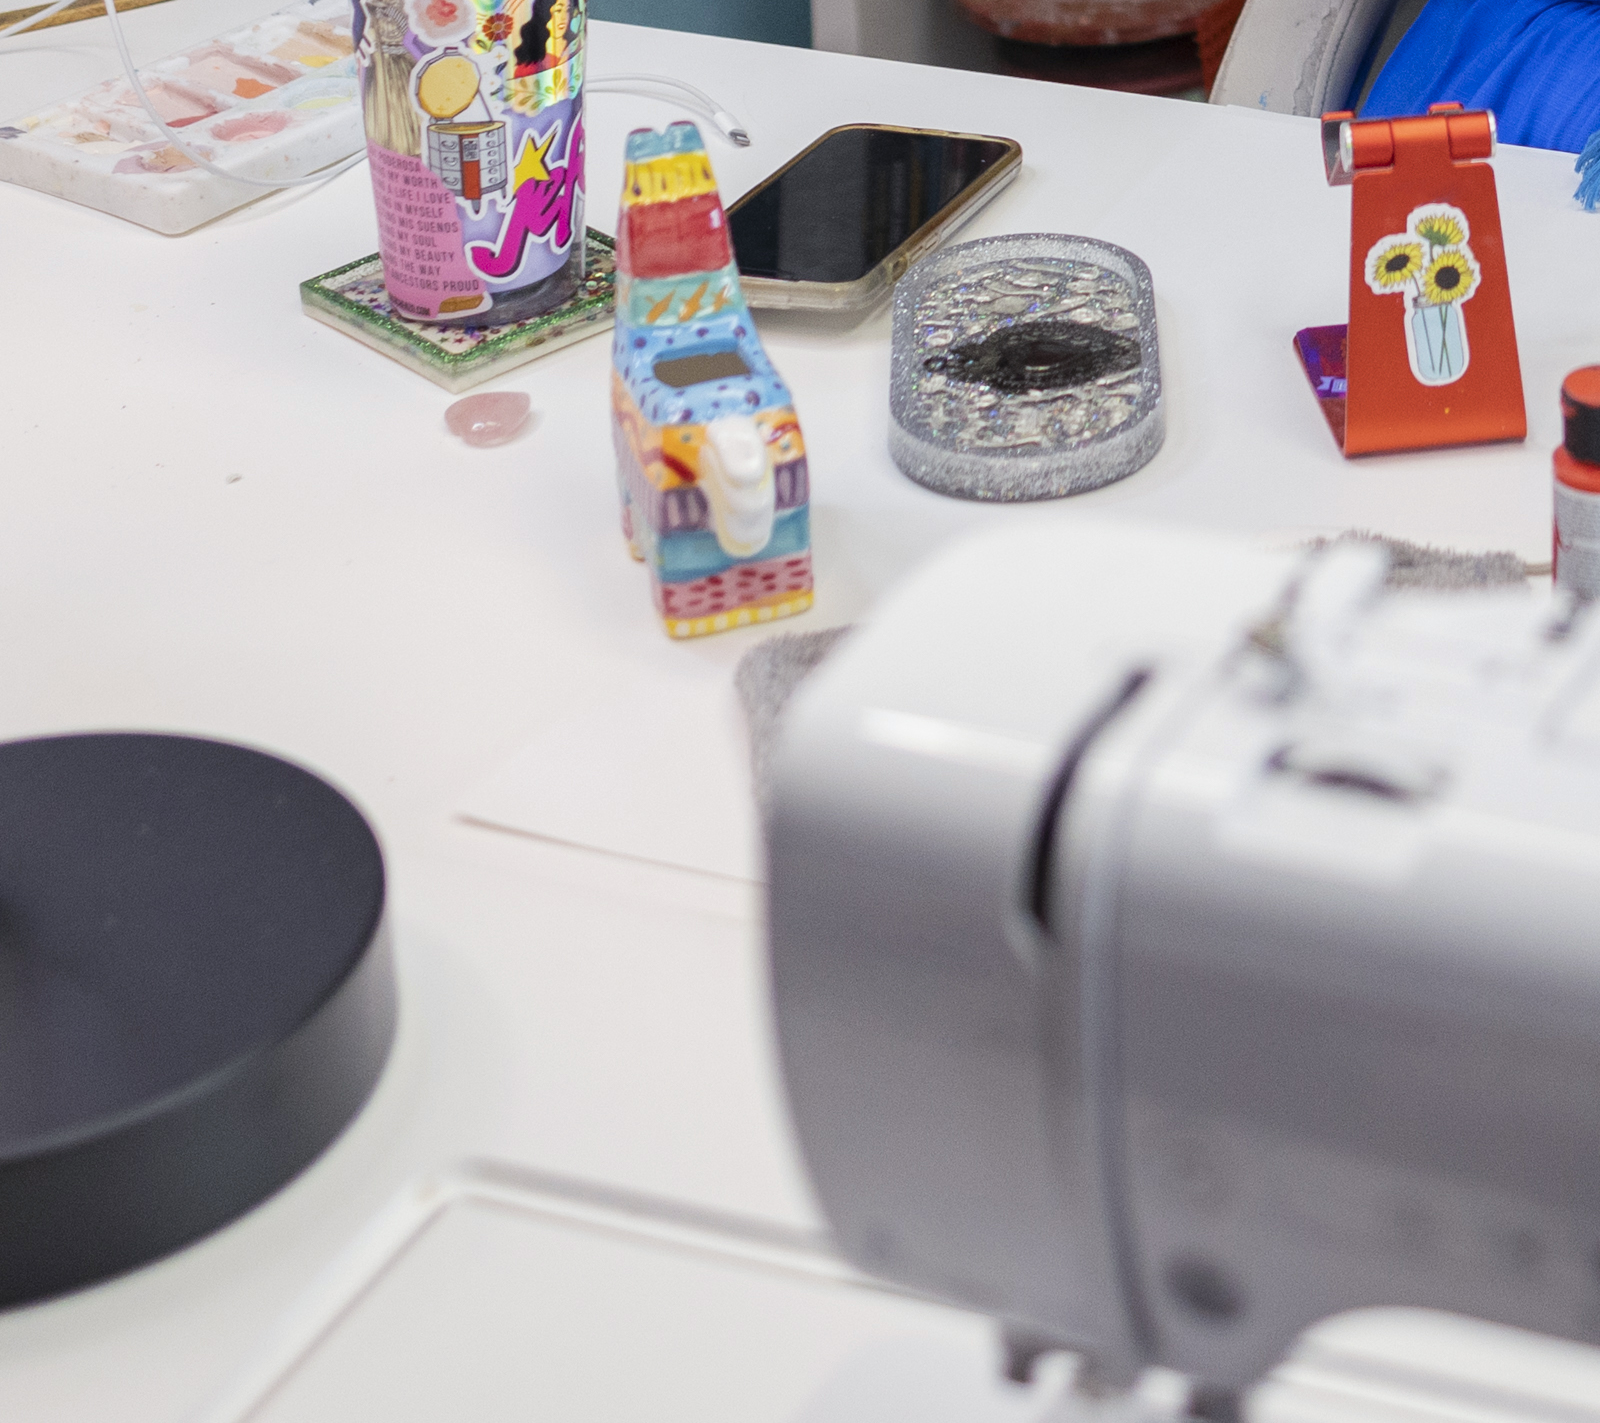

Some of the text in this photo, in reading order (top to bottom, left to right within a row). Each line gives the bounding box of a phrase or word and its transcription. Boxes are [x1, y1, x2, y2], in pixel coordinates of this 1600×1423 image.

[403, 175, 438, 189] WORTH
[424, 192, 451, 204] LOVE
[405, 203, 444, 219] MYSELF
[413, 234, 437, 248] SOUL
[415, 249, 455, 263] BEAUTY
[420, 264, 441, 276] WAY
[443, 279, 480, 292] PROUD
